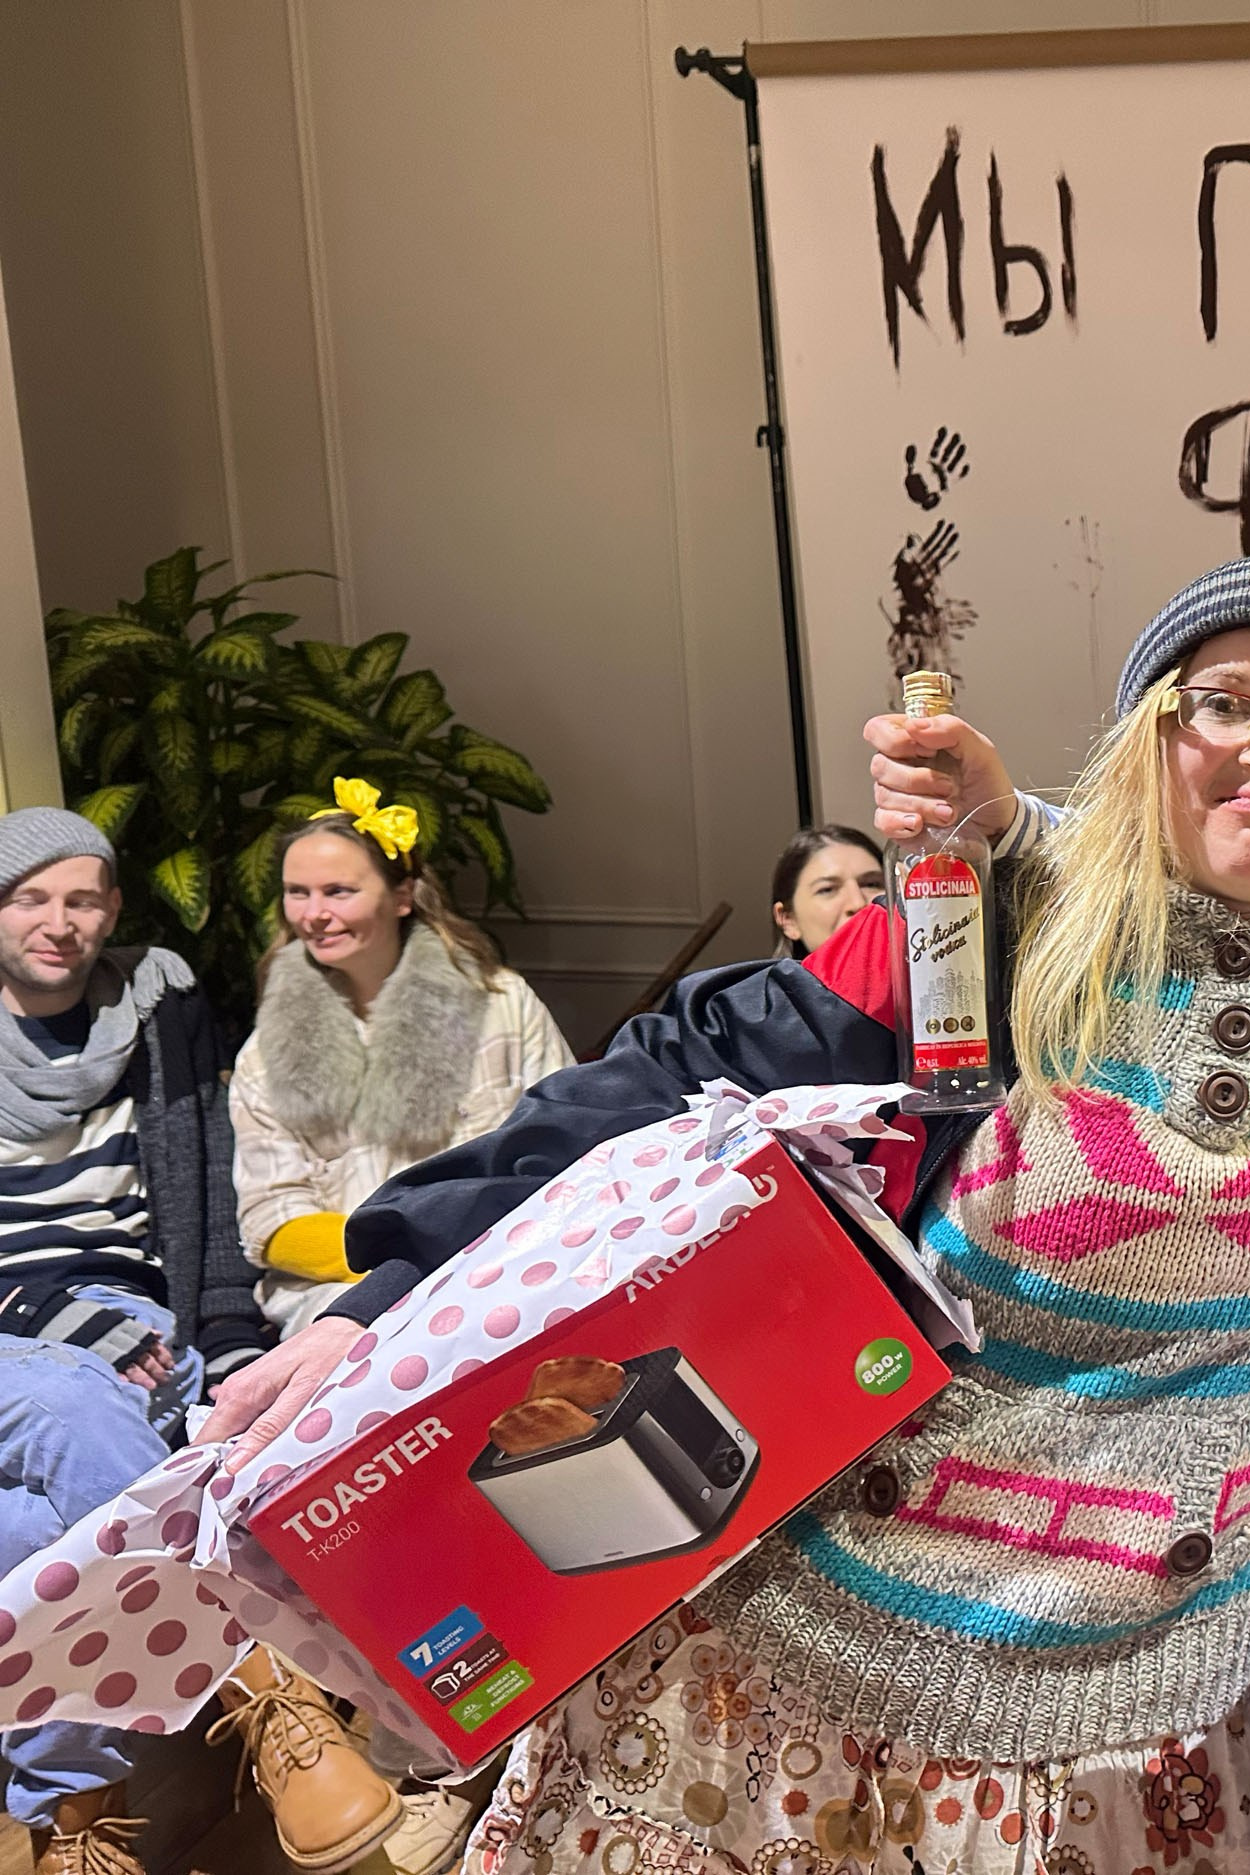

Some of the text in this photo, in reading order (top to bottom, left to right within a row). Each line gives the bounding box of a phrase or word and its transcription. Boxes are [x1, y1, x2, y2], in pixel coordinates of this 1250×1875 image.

[870, 125, 1078, 370] МЫ
[908, 879, 976, 897] STOLICINAIA
[861, 1355, 894, 1384] 800
[876, 1363, 902, 1386] POWER
[280, 1416, 454, 1543] TOASTER
[306, 1520, 361, 1562] T-K200
[409, 1625, 464, 1667] 7 TOASTING
[438, 1636, 462, 1656] LEVELS
[452, 1660, 472, 1678] 2
